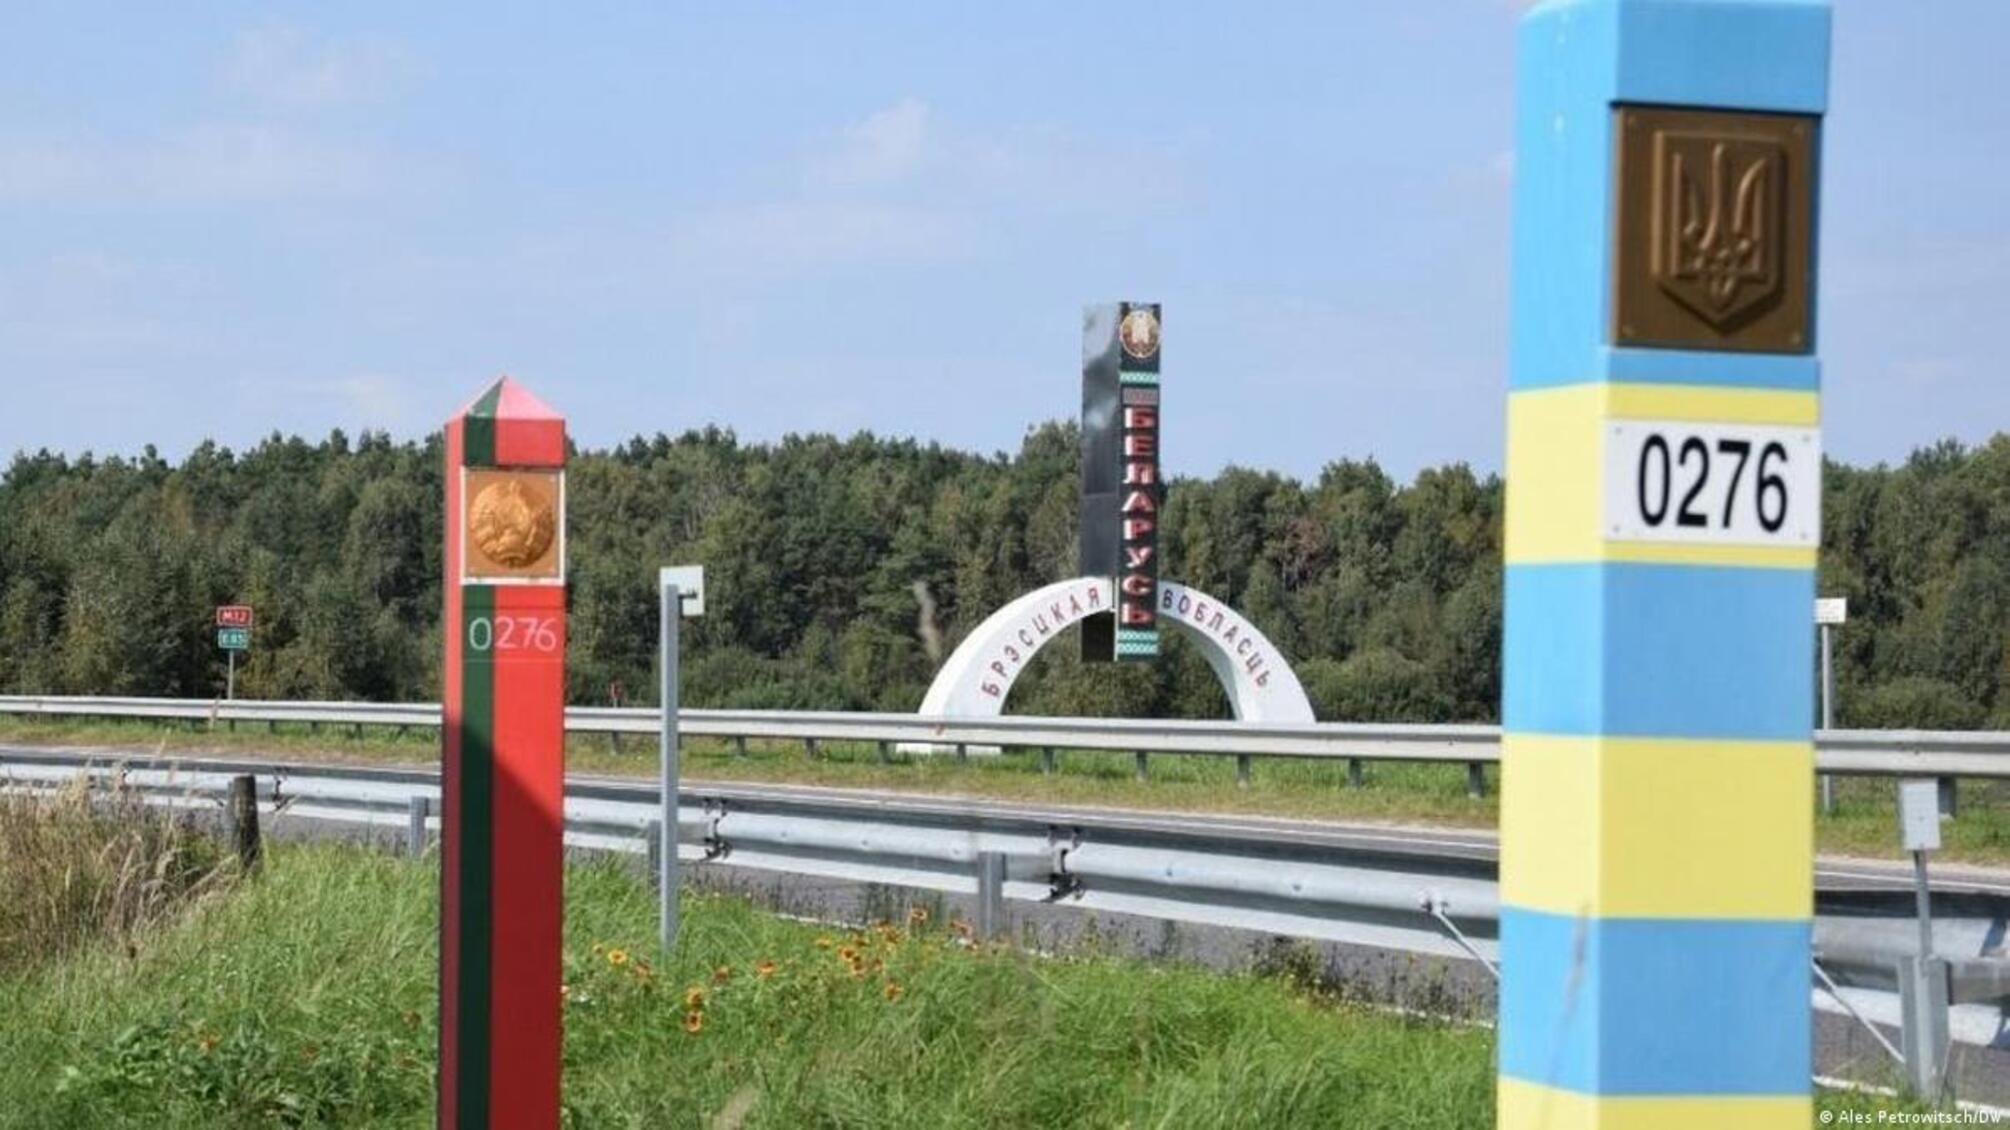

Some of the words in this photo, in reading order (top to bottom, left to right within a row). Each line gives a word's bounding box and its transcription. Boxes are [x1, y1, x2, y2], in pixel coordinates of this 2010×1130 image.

[1122, 408, 1154, 624] БЕЛАРУСЬ
[1638, 433, 1788, 533] 0276
[469, 616, 557, 652] 0276
[981, 587, 1100, 698] БРЭСЦКАЯ
[1161, 588, 1270, 688] ВОБЛАСЦЬ
